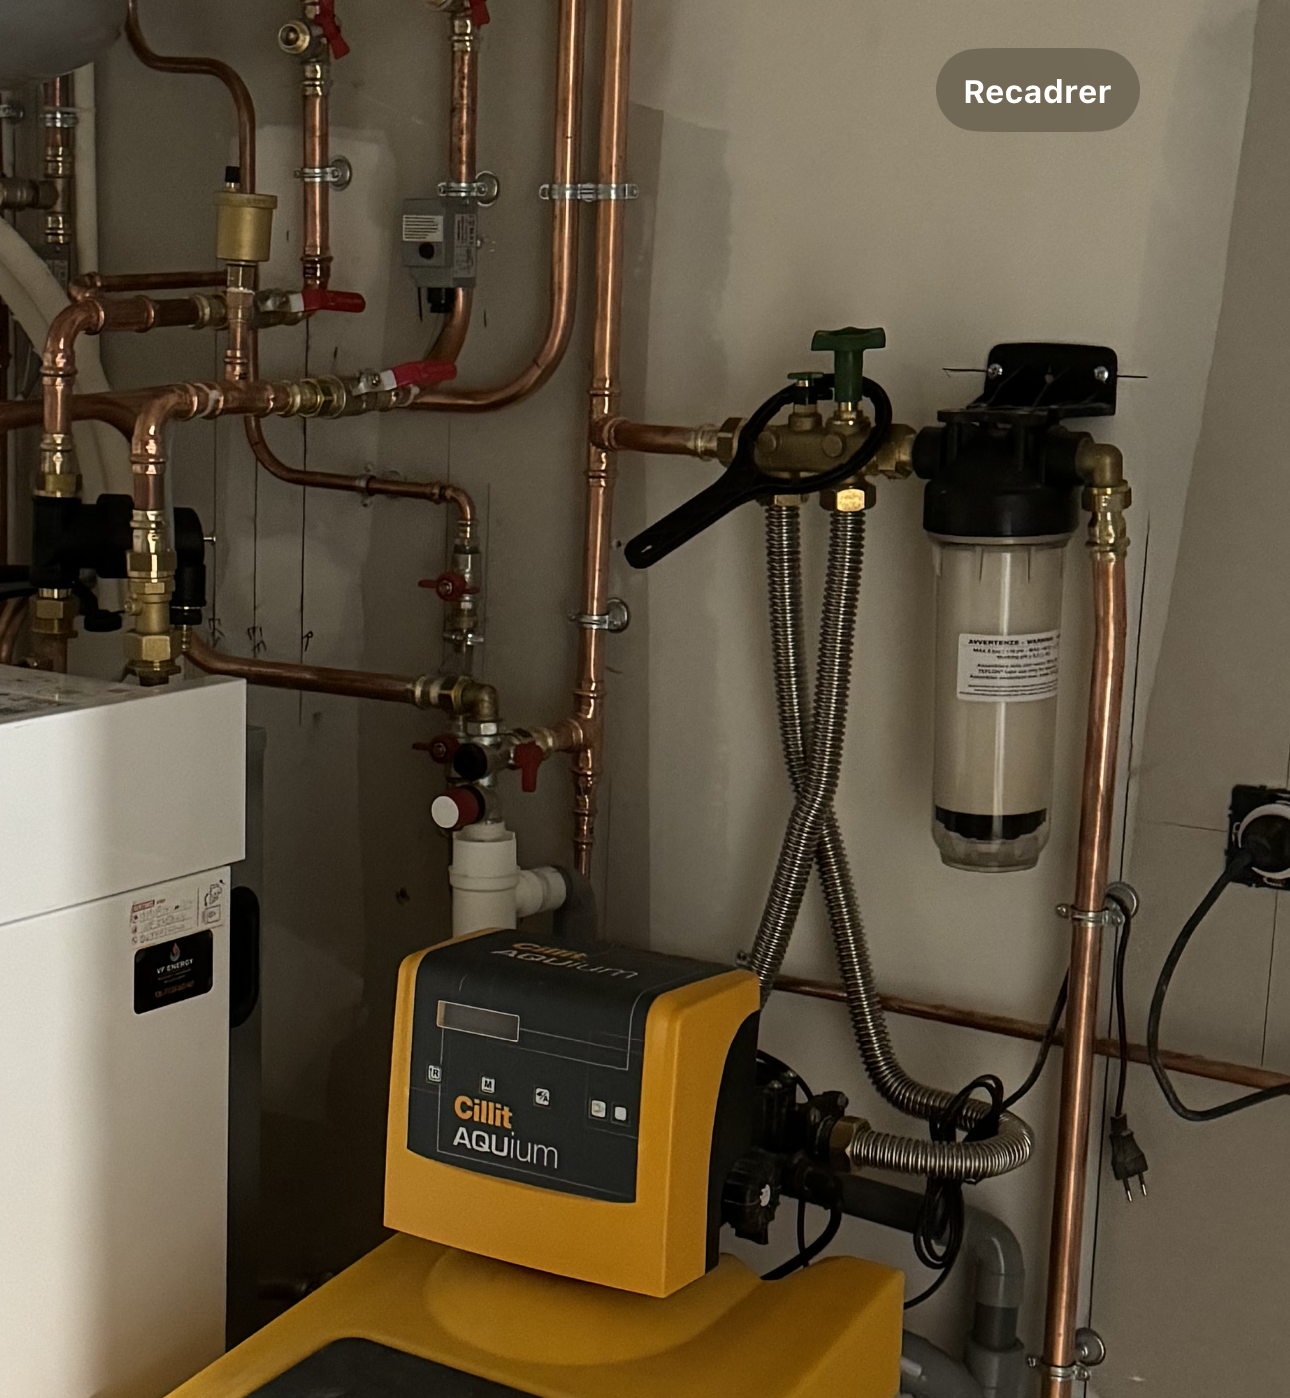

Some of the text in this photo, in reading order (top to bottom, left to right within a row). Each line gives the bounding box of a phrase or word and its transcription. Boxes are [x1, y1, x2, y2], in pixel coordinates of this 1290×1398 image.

[166, 958, 194, 972] ENERGY
[491, 949, 639, 979] AQUium
[512, 943, 587, 960] Cillit
[454, 1095, 513, 1129] Cillit
[452, 1126, 559, 1169] AQUium
